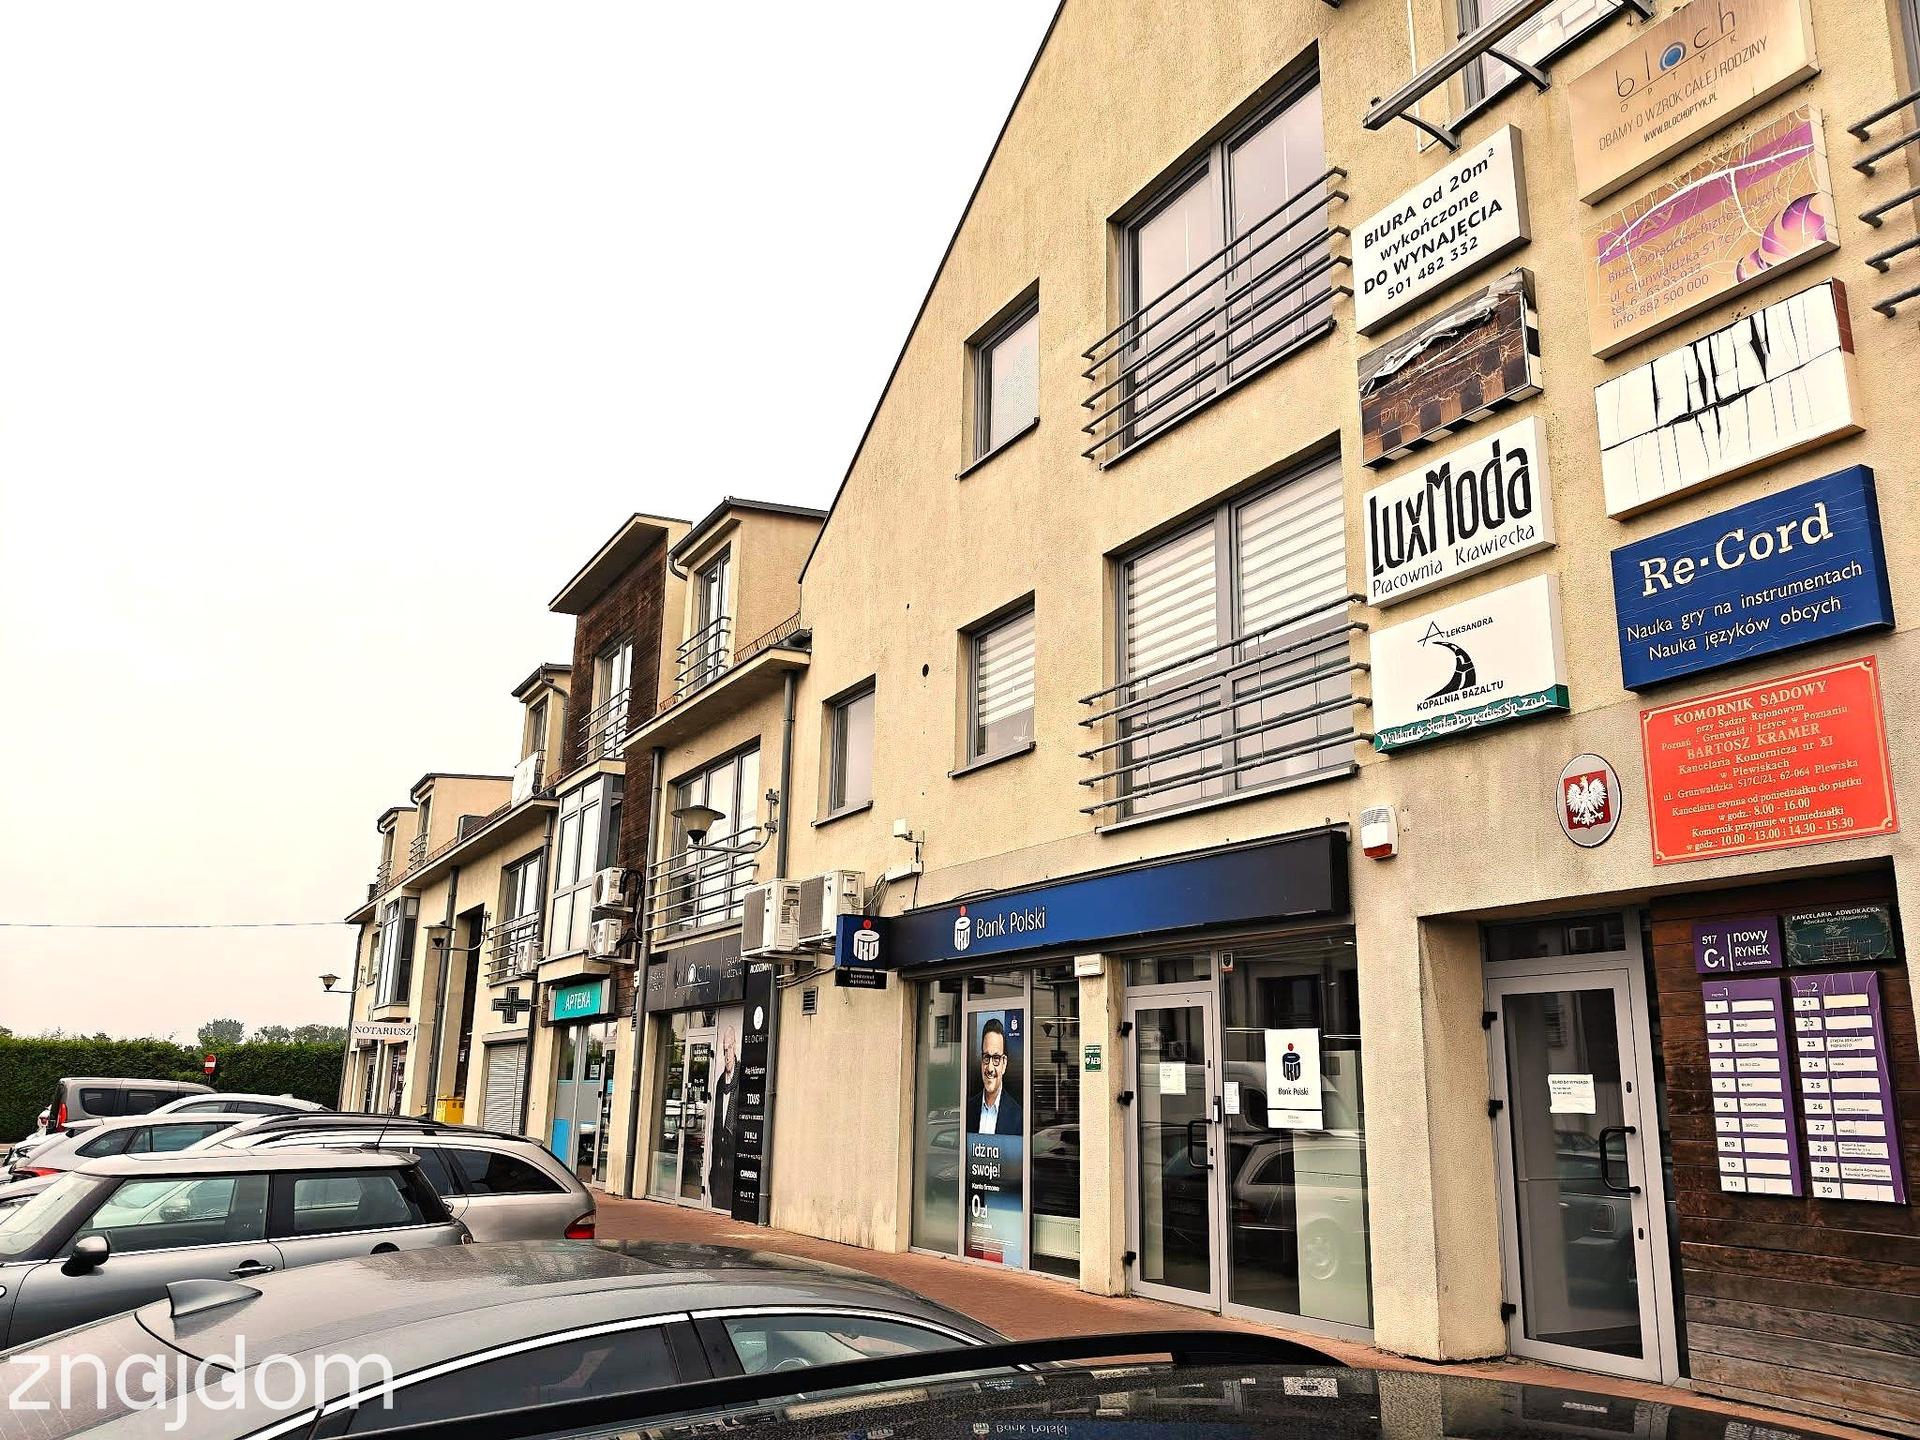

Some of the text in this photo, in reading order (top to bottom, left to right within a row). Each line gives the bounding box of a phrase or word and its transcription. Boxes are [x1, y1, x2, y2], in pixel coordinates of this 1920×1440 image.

[1615, 2, 1736, 98] bloch
[1645, 88, 1684, 122] WZROK
[1720, 36, 1768, 76] RODZINY
[1363, 206, 1417, 249] BIURA
[1422, 185, 1443, 209] od
[1380, 190, 1479, 261] wykończone
[1364, 199, 1502, 294] DO WYNAJĘCIA
[1387, 236, 1478, 299] 501 482 332
[1663, 287, 1684, 304] 500
[1686, 274, 1710, 292] 000
[1373, 524, 1535, 597] Pracownia Krawiecka
[1639, 501, 1834, 597] Re-Cord
[1627, 560, 1863, 642] Nauka gry na instrumentach
[1416, 616, 1494, 647] ALEKSANDRA
[1649, 596, 1841, 661] Nauka języków obcych
[1416, 680, 1504, 712] KOPALNIA BAZALTU
[1673, 680, 1827, 726] KOMORNIK SĄDOWY
[1661, 738, 1691, 751] Poznań
[1702, 727, 1745, 742] Grunwald
[1749, 724, 1753, 733] i
[1803, 706, 1848, 721] Poznaniu
[1696, 723, 1714, 734] przy
[1751, 704, 1805, 721] Rejonowym
[1678, 735, 1834, 775] Kancelaria Komornicza nr XI
[1687, 722, 1822, 760] BARTOSZ KRAMER
[1663, 791, 1673, 801] ul.
[1677, 782, 1734, 798] Grunwaldzka
[1780, 767, 1810, 780] 62-064
[1814, 759, 1859, 774] Plewiska
[1720, 759, 1790, 779] w Plewiskach
[1671, 803, 1715, 816] Kancelaria
[1717, 798, 1746, 809] czynna
[1747, 794, 1758, 803] od
[1760, 786, 1817, 804] poniedziałku
[1819, 783, 1830, 792] do
[1727, 810, 1751, 822] godz.:
[1753, 803, 1775, 816] 8.00
[1783, 797, 1811, 811] 16.00
[1686, 843, 1694, 851] w
[1694, 840, 1718, 852] godz.:
[1720, 833, 1746, 846] 10.00
[1754, 828, 1780, 841] 13.00
[1788, 823, 1816, 836] 14.30
[1825, 817, 1854, 831] 15.30
[1692, 805, 1845, 838] Komornik przyjmuje w poniedziałki
[976, 906, 1045, 939] Bank Polski
[1791, 911, 1833, 921] KANCELARIA
[1702, 934, 1717, 945] 517
[1733, 929, 1768, 943] nowy
[1734, 944, 1770, 957] RYNEK
[564, 991, 592, 1011] APTEKA
[1810, 981, 1818, 992] 2
[354, 1025, 414, 1036] NOTARIUSZ
[746, 1093, 760, 1105] TOUS
[1278, 1087, 1309, 1095] Bank Polski
[972, 1142, 999, 1158] Idź na
[971, 1162, 1001, 1180] swoje!
